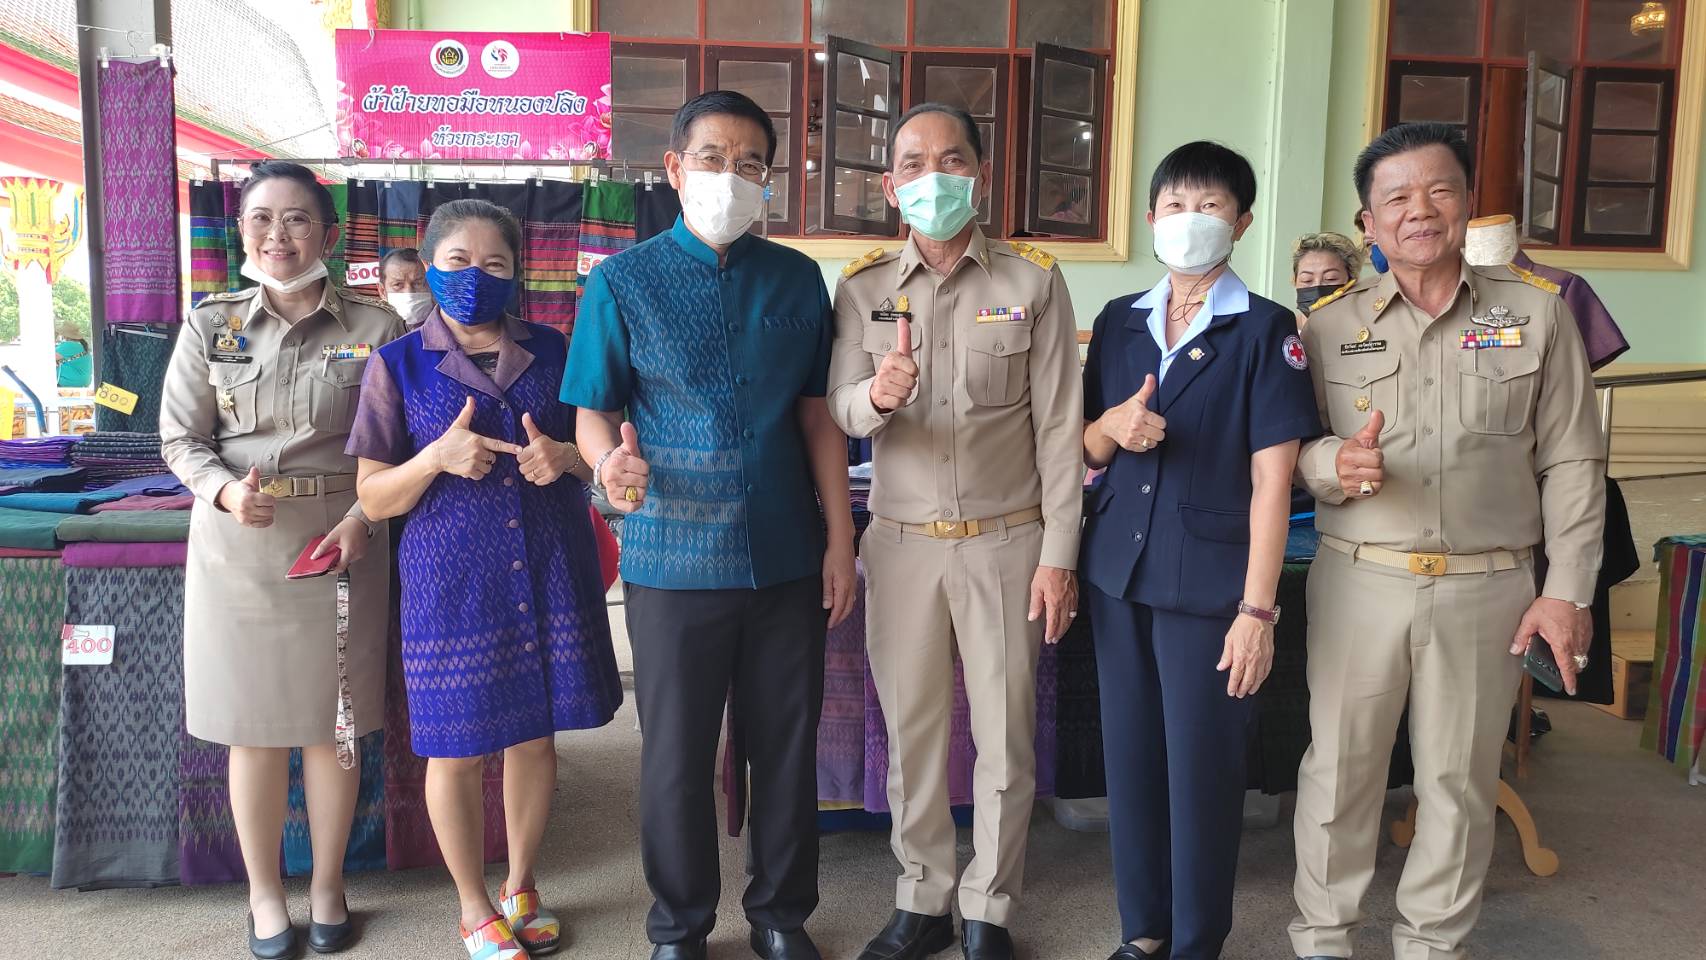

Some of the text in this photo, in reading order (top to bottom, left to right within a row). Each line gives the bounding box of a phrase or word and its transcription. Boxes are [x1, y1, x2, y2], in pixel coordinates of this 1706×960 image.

[363, 86, 586, 115] ผ้าฝ้ายทอมือหนองปลิง
[432, 126, 520, 147] ห้วยกระเจา
[65, 637, 112, 654] 400
